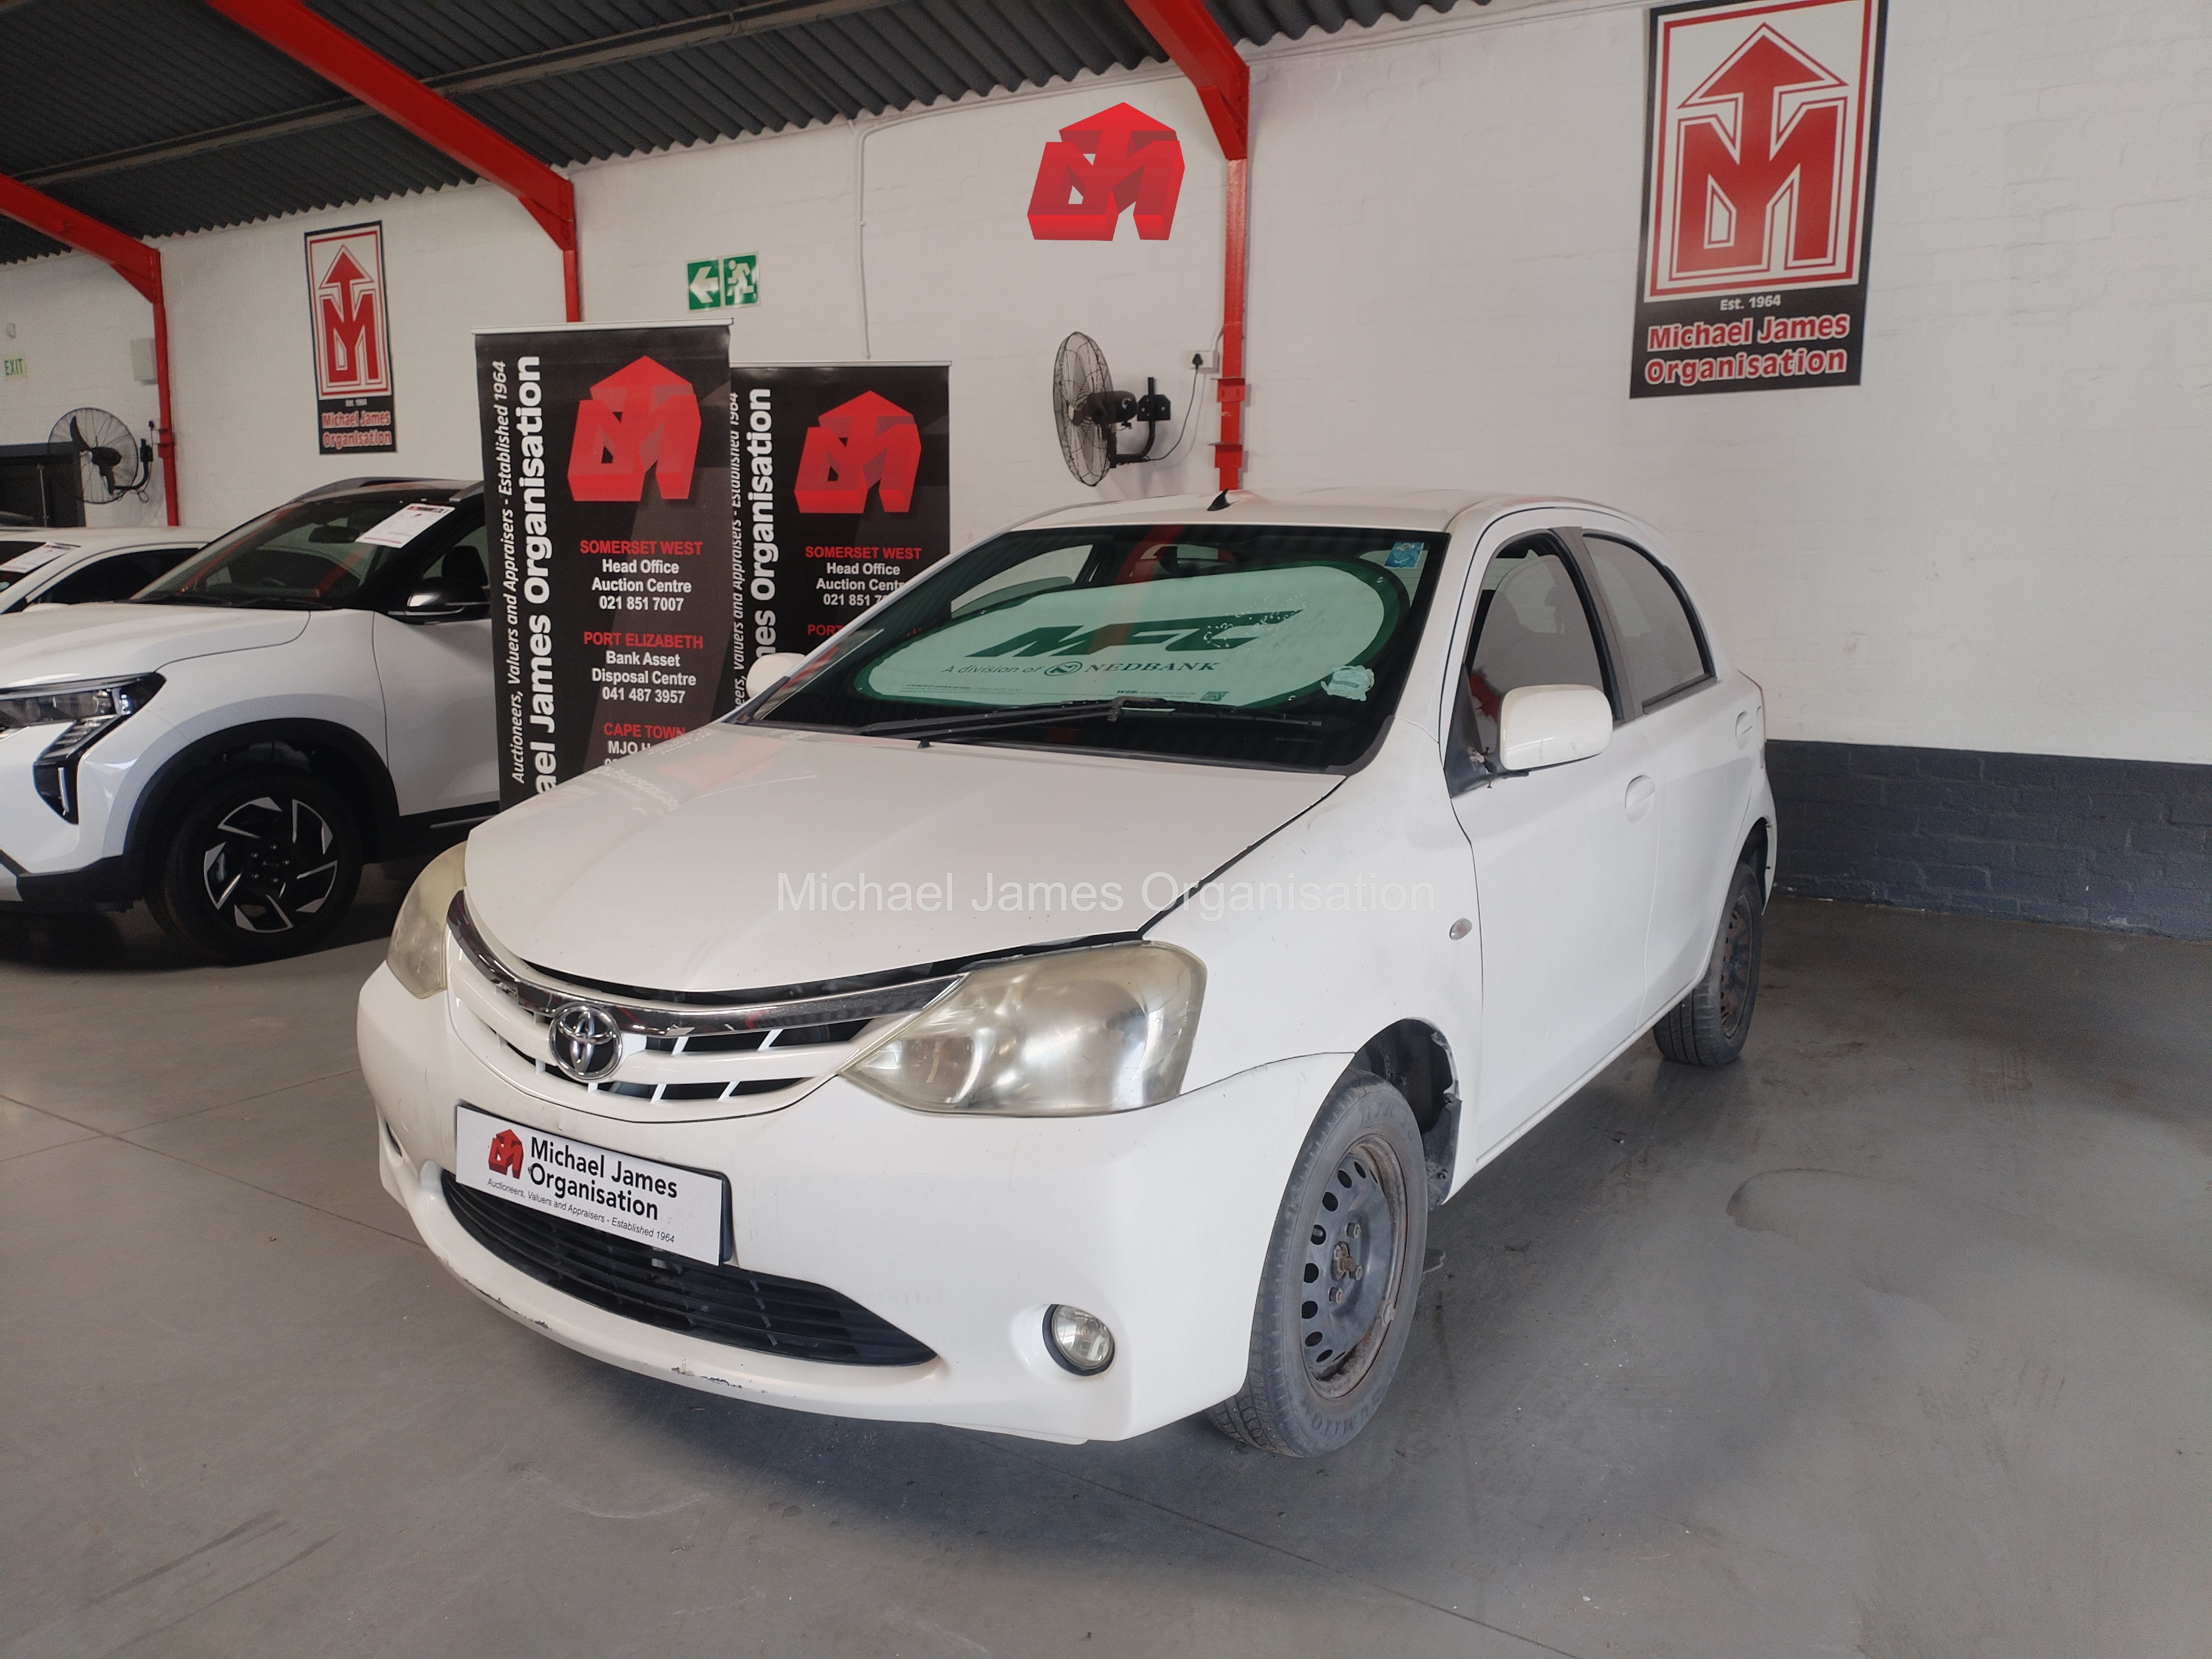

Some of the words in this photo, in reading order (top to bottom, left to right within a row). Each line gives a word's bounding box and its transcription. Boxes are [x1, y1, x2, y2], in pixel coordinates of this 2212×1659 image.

[1721, 299, 1744, 311] Est.
[1748, 294, 1782, 308] 1964
[1647, 318, 1754, 352] Michael
[1757, 314, 1850, 343] James
[4, 358, 23, 375] EXIT
[1645, 348, 1847, 386] Organisation
[492, 360, 508, 400] 1964
[322, 410, 359, 428] Michael
[360, 410, 391, 427] James
[323, 429, 393, 450] Organisation
[494, 404, 512, 496] Established
[516, 356, 552, 604] Organisation
[746, 388, 779, 601] Organisation
[501, 508, 520, 592] Appraisers
[579, 540, 657, 555] SOMERSET
[660, 541, 703, 555] WEST
[805, 547, 879, 558] SOMERSET
[882, 547, 922, 559] WEST
[602, 559, 637, 574] Head
[640, 560, 679, 574] Office
[826, 562, 859, 574] Head
[862, 563, 901, 575] Office
[592, 577, 644, 592] Auction
[648, 578, 692, 593] Centre
[816, 578, 865, 590] Auction
[869, 579, 906, 591] Centr
[504, 593, 519, 625] and
[599, 596, 622, 610] 021
[626, 596, 649, 610] 851
[653, 597, 684, 611] 7007
[823, 594, 844, 605] 021
[848, 594, 870, 606] 851
[584, 632, 622, 646] PORT
[625, 633, 703, 649] ELIZABETH
[507, 628, 521, 685] Valuers
[606, 651, 640, 665] Bank
[643, 652, 680, 667] Asset
[529, 614, 555, 733] James
[957, 664, 1017, 673] division
[1083, 662, 1220, 673] NEDBANK
[592, 669, 648, 685] Disposal
[652, 671, 696, 685] Centre
[602, 686, 624, 701] 041
[629, 687, 652, 702] 487
[655, 689, 685, 704] 3957
[510, 691, 525, 784] Auctioneers,
[603, 723, 642, 737] CAPE
[645, 725, 685, 739] TOWN
[608, 740, 638, 754] MJO
[530, 1136, 604, 1177] Michael
[611, 1161, 677, 1198] James
[529, 1163, 658, 1220] Organisation
[487, 1178, 525, 1198] Auctioneers,
[528, 1191, 552, 1208] Valuers
[554, 1198, 567, 1211] and
[568, 1203, 605, 1224] Appraisers
[611, 1217, 655, 1238] Established
[656, 1231, 675, 1244] 1964
